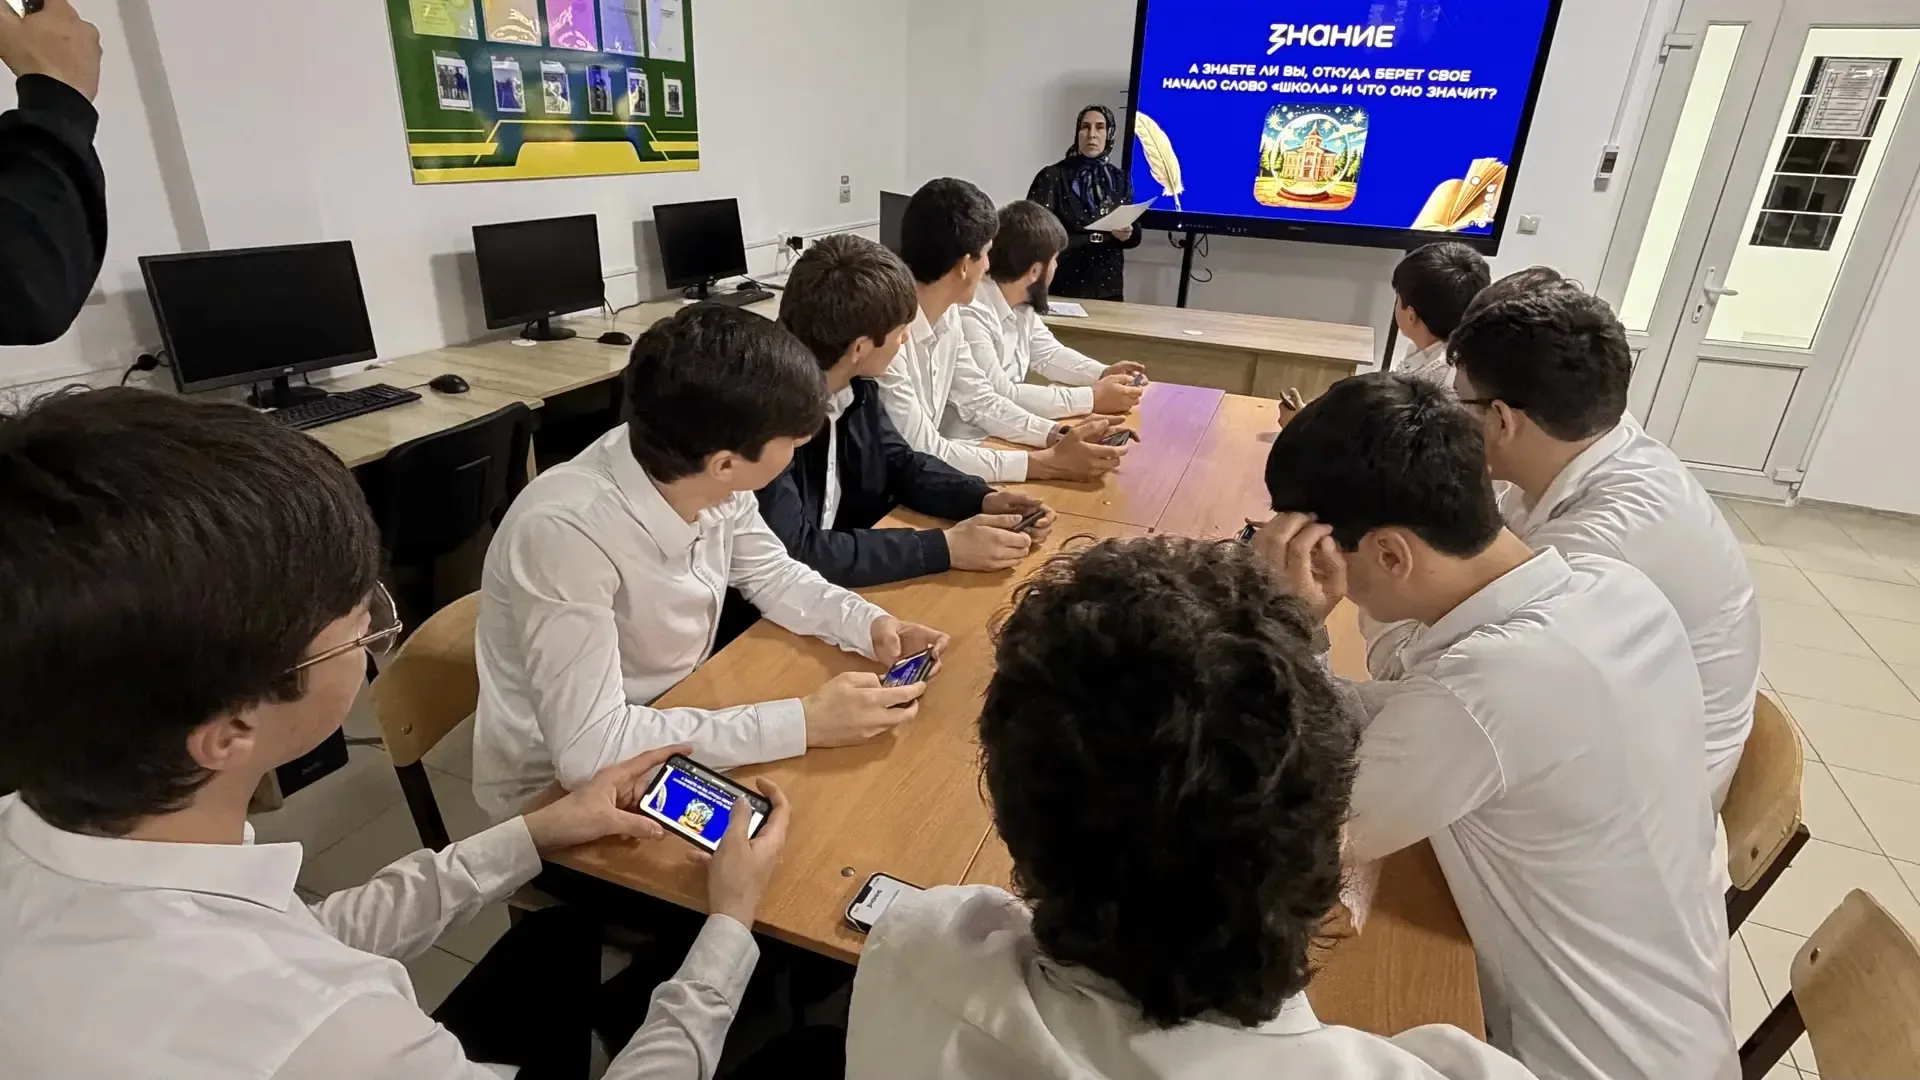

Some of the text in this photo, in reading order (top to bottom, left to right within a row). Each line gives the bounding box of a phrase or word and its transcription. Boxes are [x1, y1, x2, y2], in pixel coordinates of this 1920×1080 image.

[1188, 63, 1472, 83] А ЗНАЕТЕ ЛИ ВЫ, ОТКУДА БЕРЕТ СВОЕ
[1162, 77, 1498, 100] НАЧАЛО СЛОВО «ШКОЛА» И ЧТО ОНО ЗНАЧИТ?
